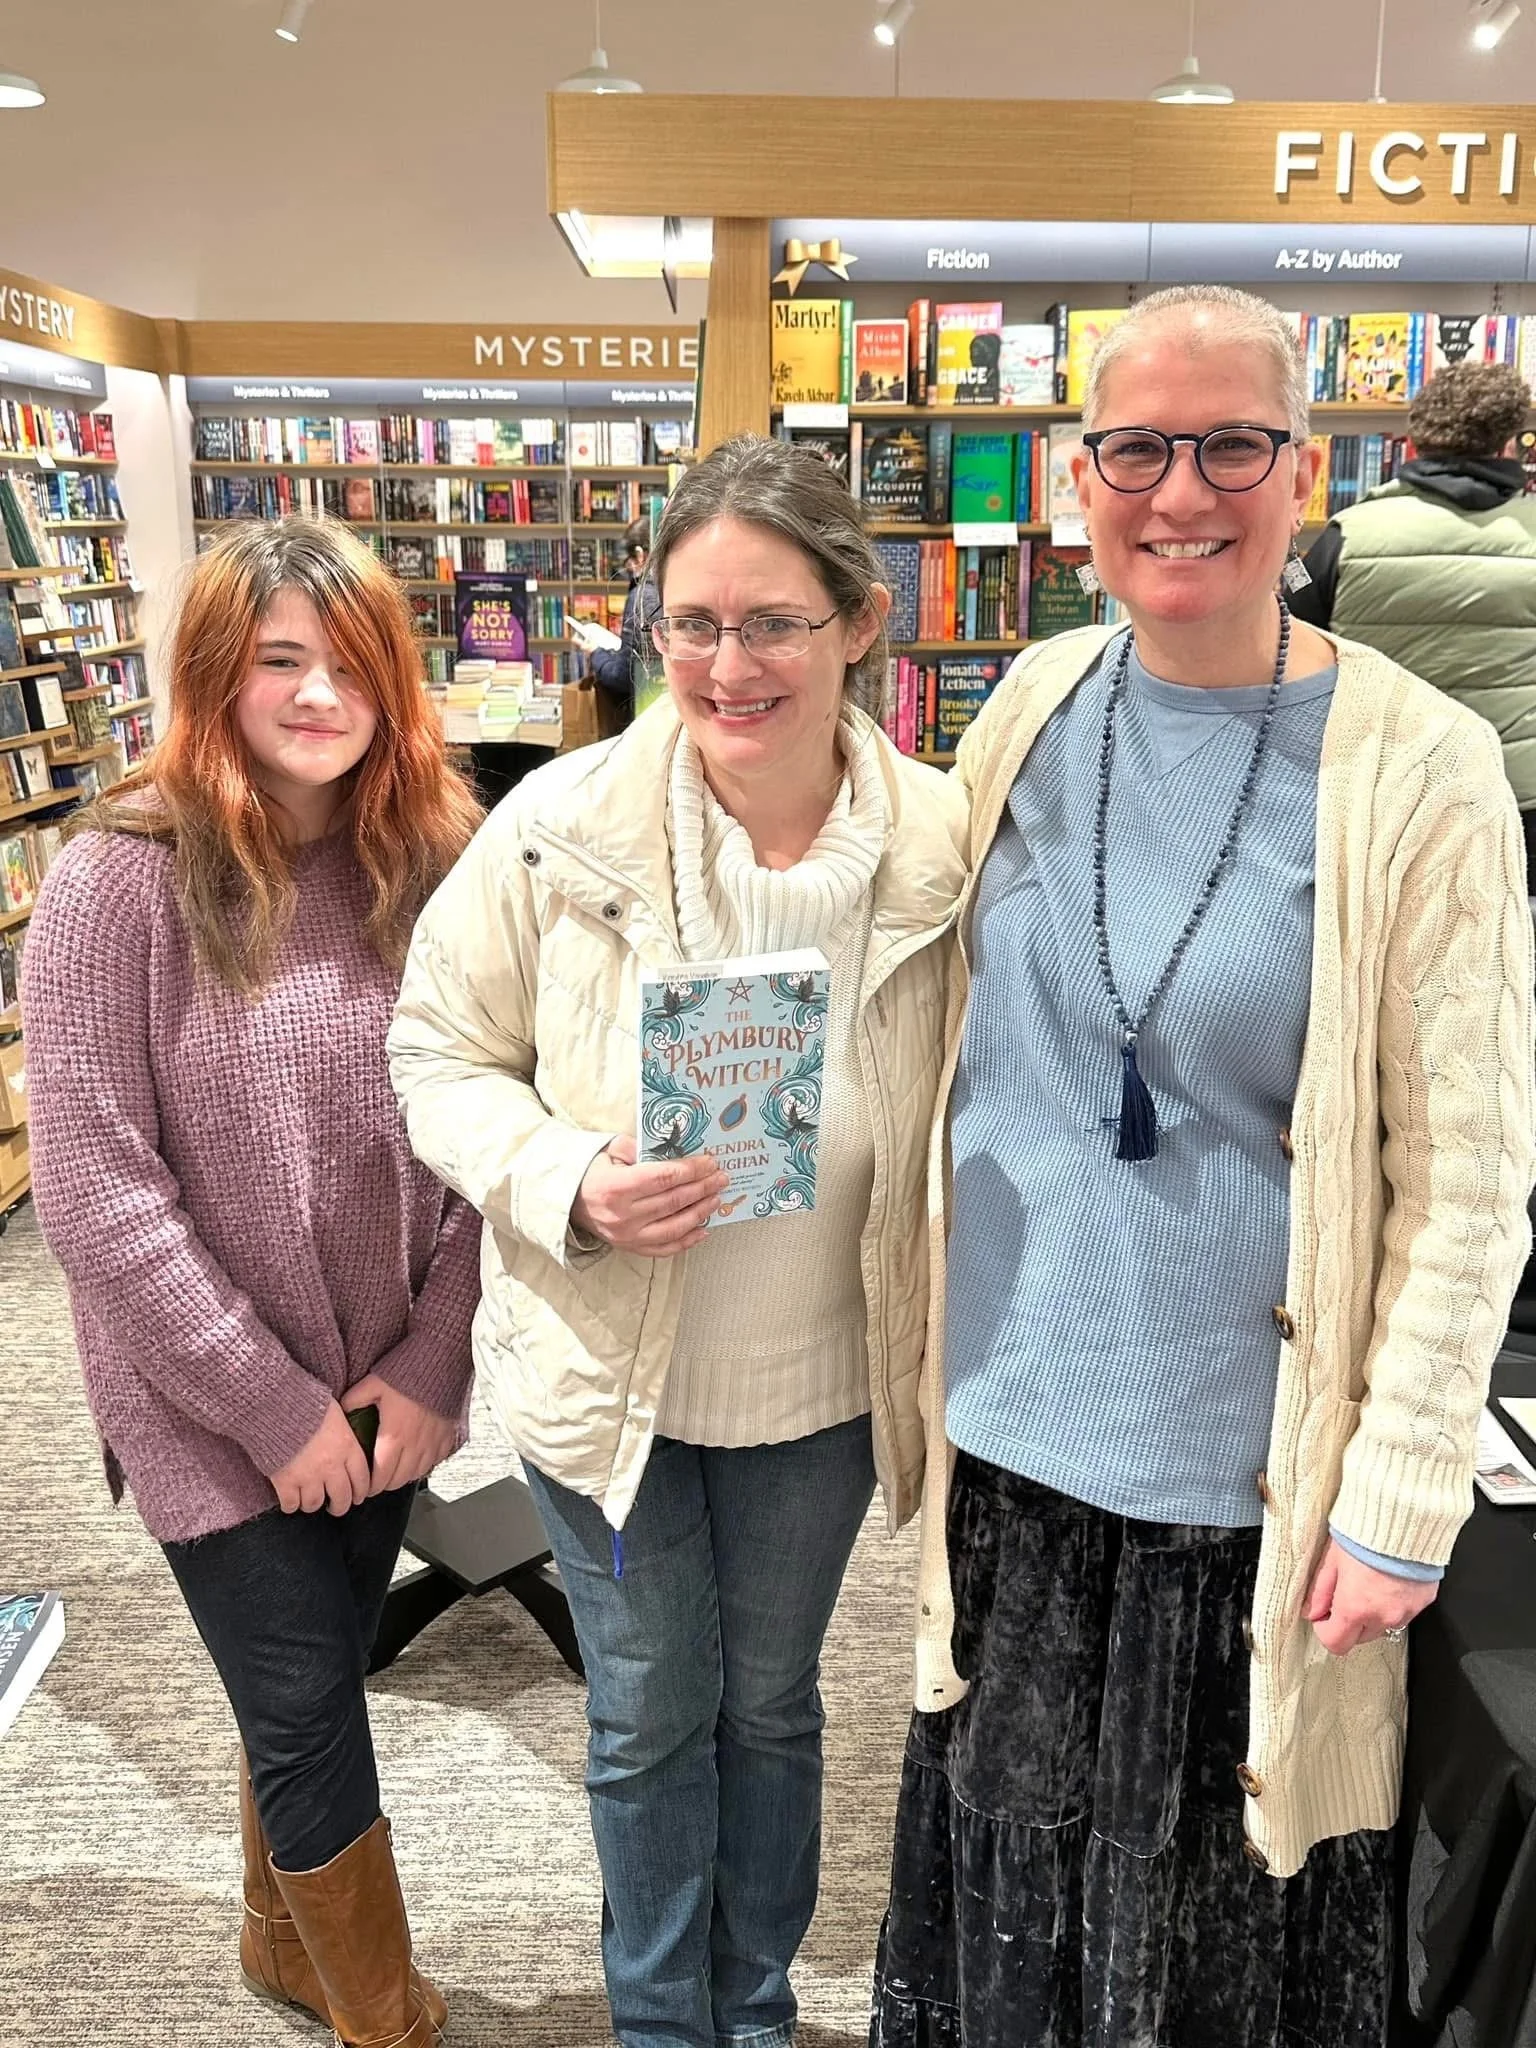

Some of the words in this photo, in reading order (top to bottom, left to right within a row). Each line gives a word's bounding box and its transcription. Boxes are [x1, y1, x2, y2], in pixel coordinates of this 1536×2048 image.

[1274, 131, 1536, 195] FICTI
[927, 247, 990, 269] Fiction
[1275, 249, 1308, 269] A-Z
[1312, 249, 1336, 272] by
[1337, 249, 1402, 269] Author
[0, 285, 75, 341] YSTERY
[775, 304, 836, 333] Martyr!
[863, 330, 899, 343] Mitch
[475, 336, 698, 368] MYSTERIE
[233, 385, 280, 400] Mysteries
[281, 386, 290, 398] &
[866, 482, 922, 492] JACQUOTTE
[473, 600, 511, 612] SHE'S
[472, 613, 511, 628] NOT
[471, 629, 514, 640] SORRY
[940, 664, 984, 677] Jonath
[940, 678, 986, 690] Lethem
[725, 1010, 752, 1023] THE
[664, 1025, 807, 1073] PLYMBURY
[686, 1057, 783, 1089] WITCH
[703, 1138, 766, 1157] KENDRA
[717, 1153, 770, 1171] UGHAN
